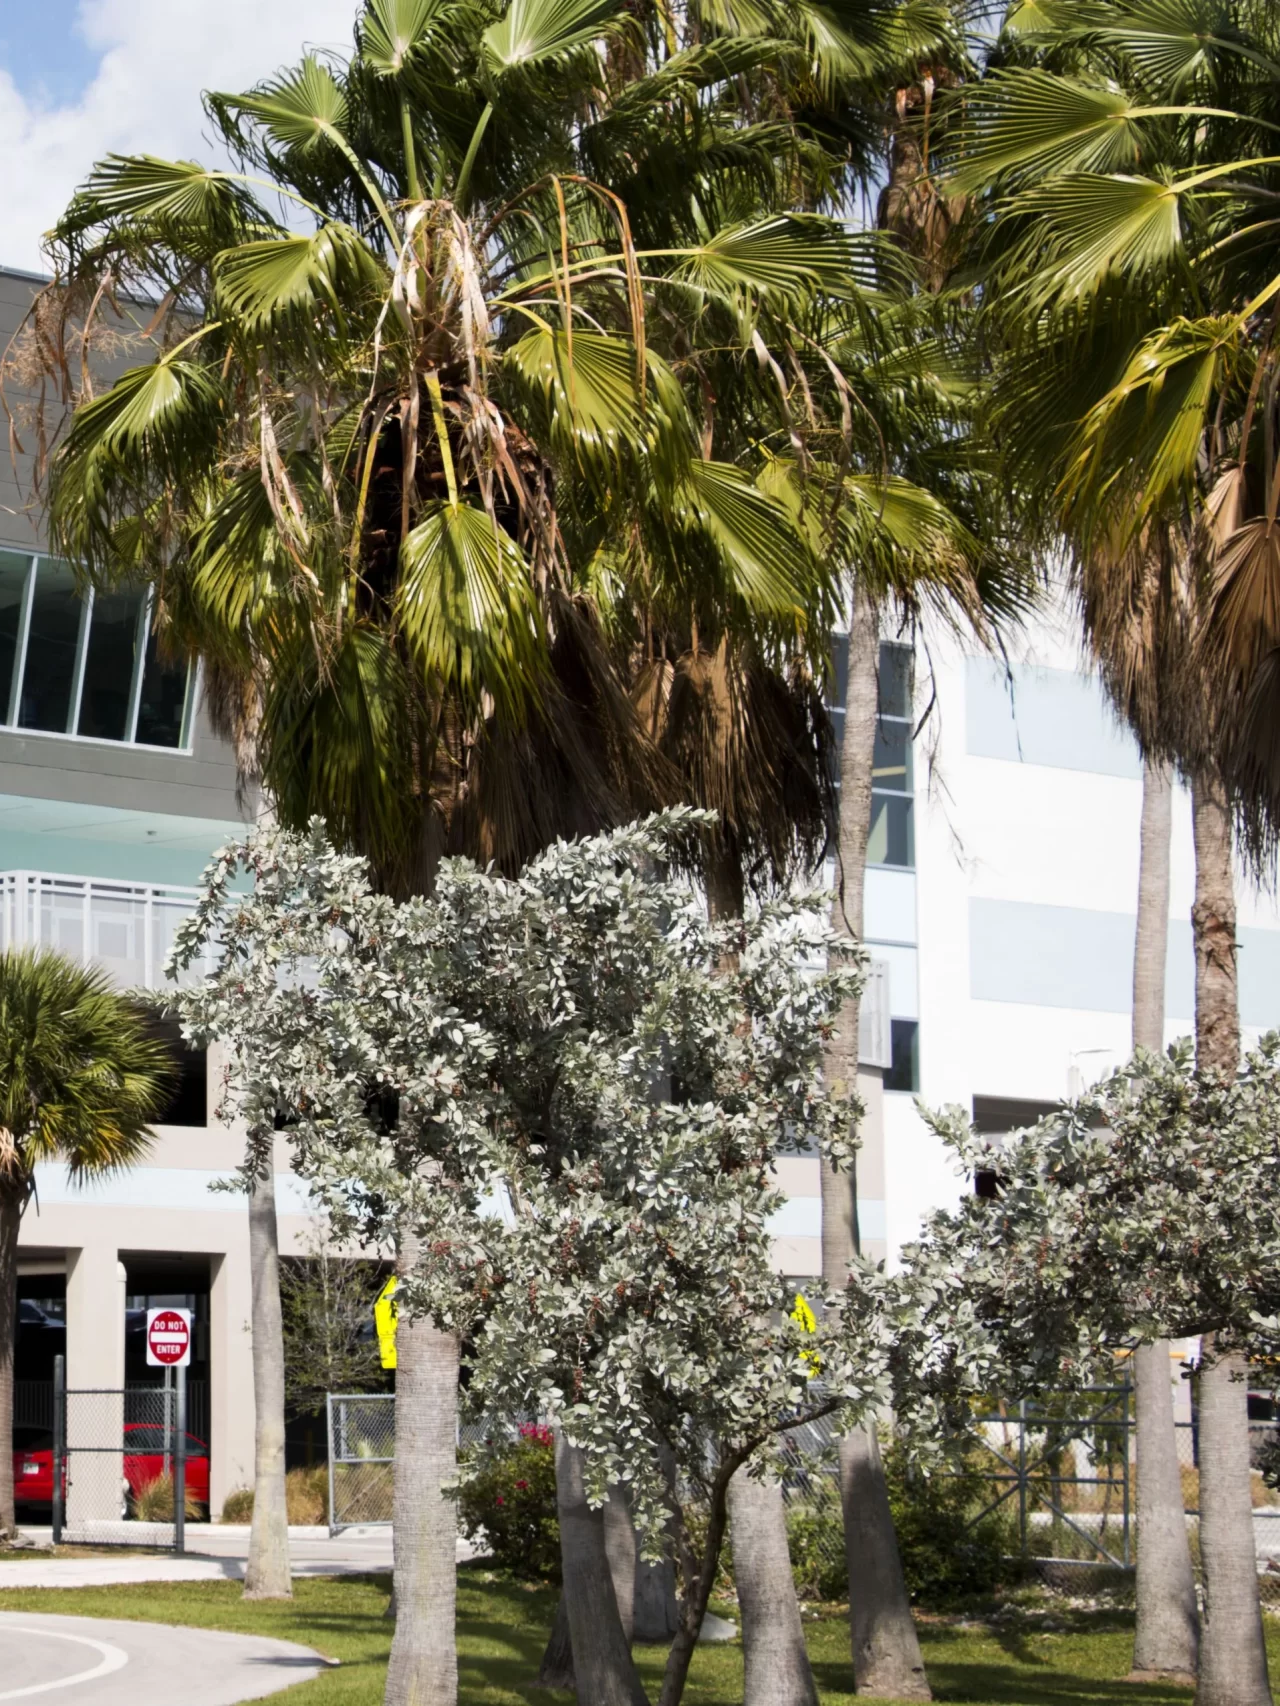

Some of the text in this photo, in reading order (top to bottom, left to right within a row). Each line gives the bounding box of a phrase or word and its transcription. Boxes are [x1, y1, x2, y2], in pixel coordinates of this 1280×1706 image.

[154, 1320, 183, 1331] DO NOT
[156, 1344, 181, 1355] ENTER
